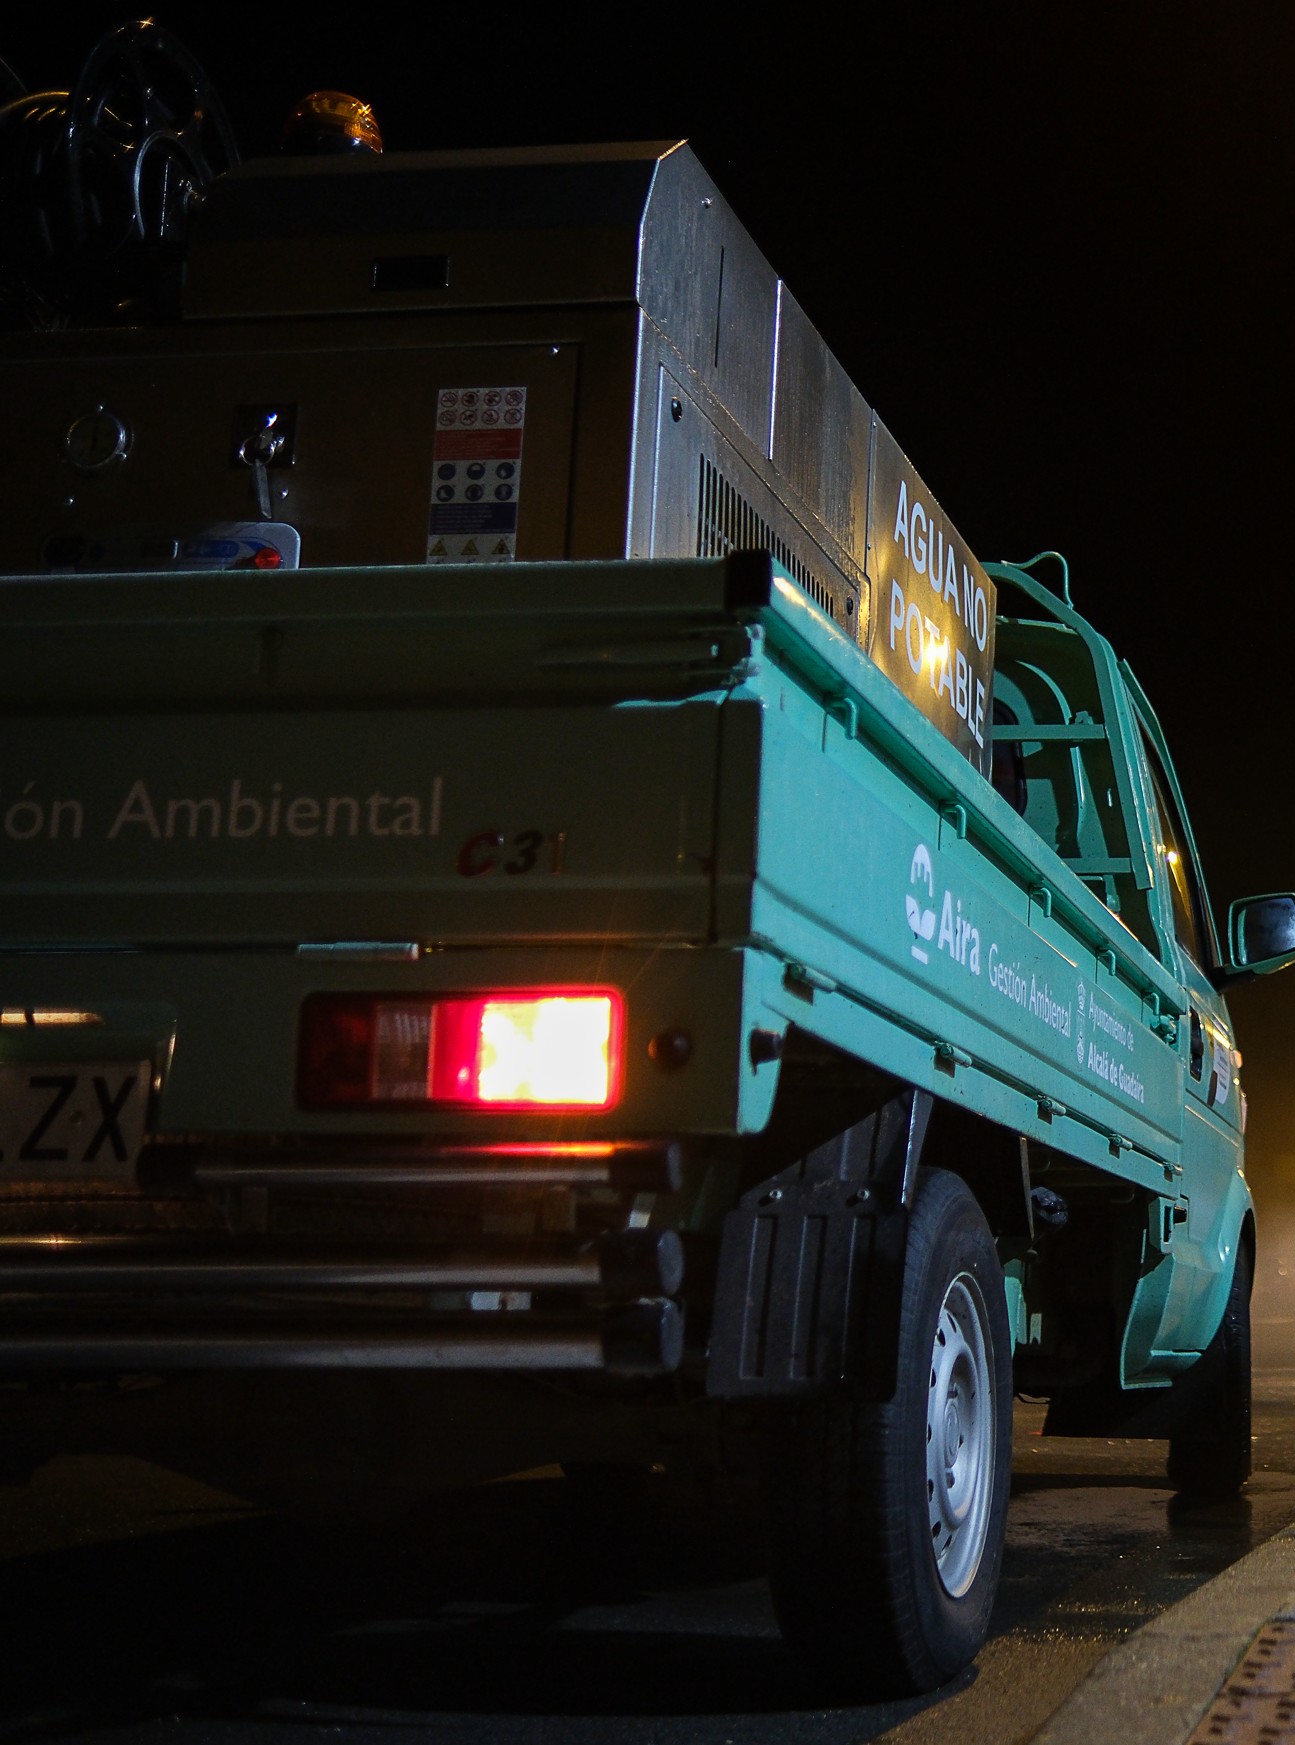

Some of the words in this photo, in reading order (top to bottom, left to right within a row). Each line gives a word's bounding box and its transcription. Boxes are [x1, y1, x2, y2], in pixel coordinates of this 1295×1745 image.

[893, 479, 961, 617] AGUA
[963, 564, 988, 653] NO
[889, 578, 985, 750] POTABLE
[106, 775, 444, 840] Ambiental
[456, 829, 567, 879] C31
[937, 889, 981, 976] Aira
[988, 943, 1027, 1008] Gestión
[1028, 973, 1072, 1039] Ambiental
[1087, 1042, 1109, 1080] Alcalá
[1109, 1058, 1118, 1087] de
[1118, 1063, 1145, 1104] Guadaíra
[1127, 1023, 1134, 1052] de
[0, 1075, 138, 1163] ZX
